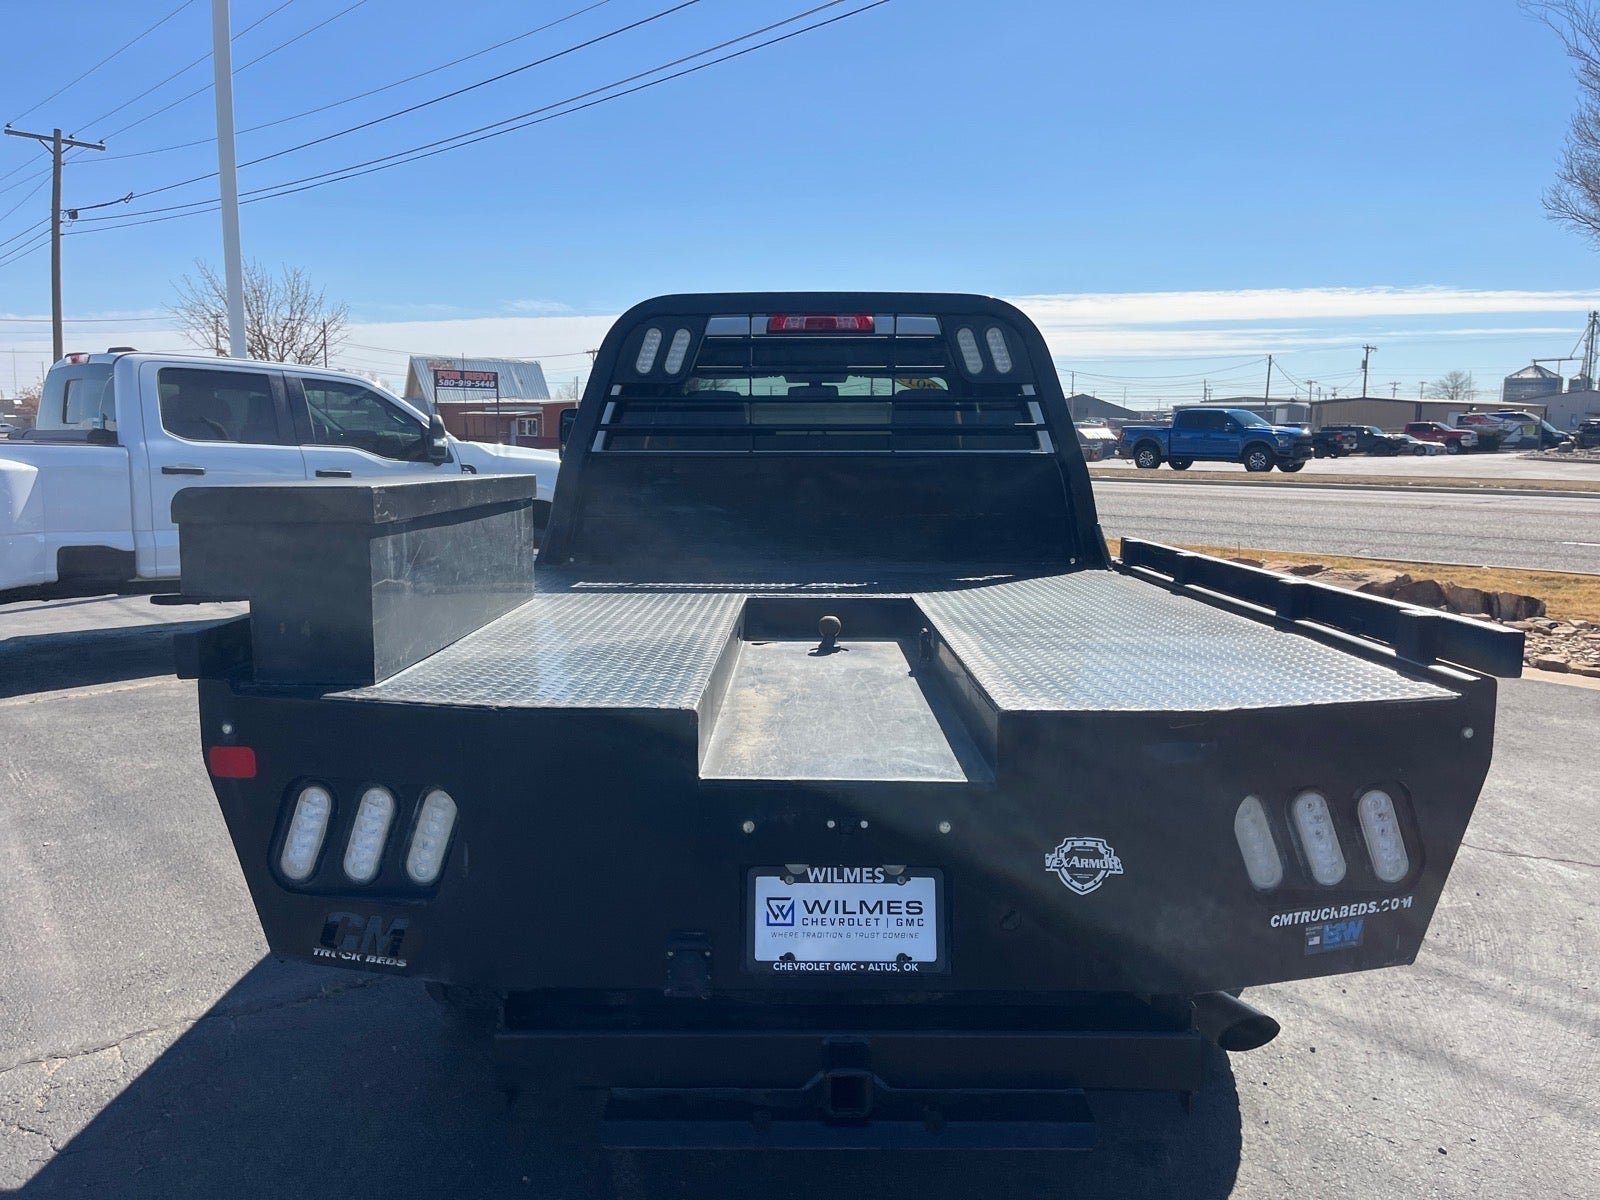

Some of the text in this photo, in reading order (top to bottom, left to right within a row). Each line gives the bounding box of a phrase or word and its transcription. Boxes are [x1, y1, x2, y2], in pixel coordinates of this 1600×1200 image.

[437, 371, 495, 382] FOR RENT
[806, 867, 885, 883] WILMES
[802, 899, 924, 915] WILMES
[801, 917, 924, 927] CHEVROLET GMC
[771, 931, 799, 939] WHERE
[802, 931, 843, 939] TRADITION
[365, 955, 408, 967] BEDS
[773, 962, 919, 972] CHEVROLET GMC ALTUS, OK
